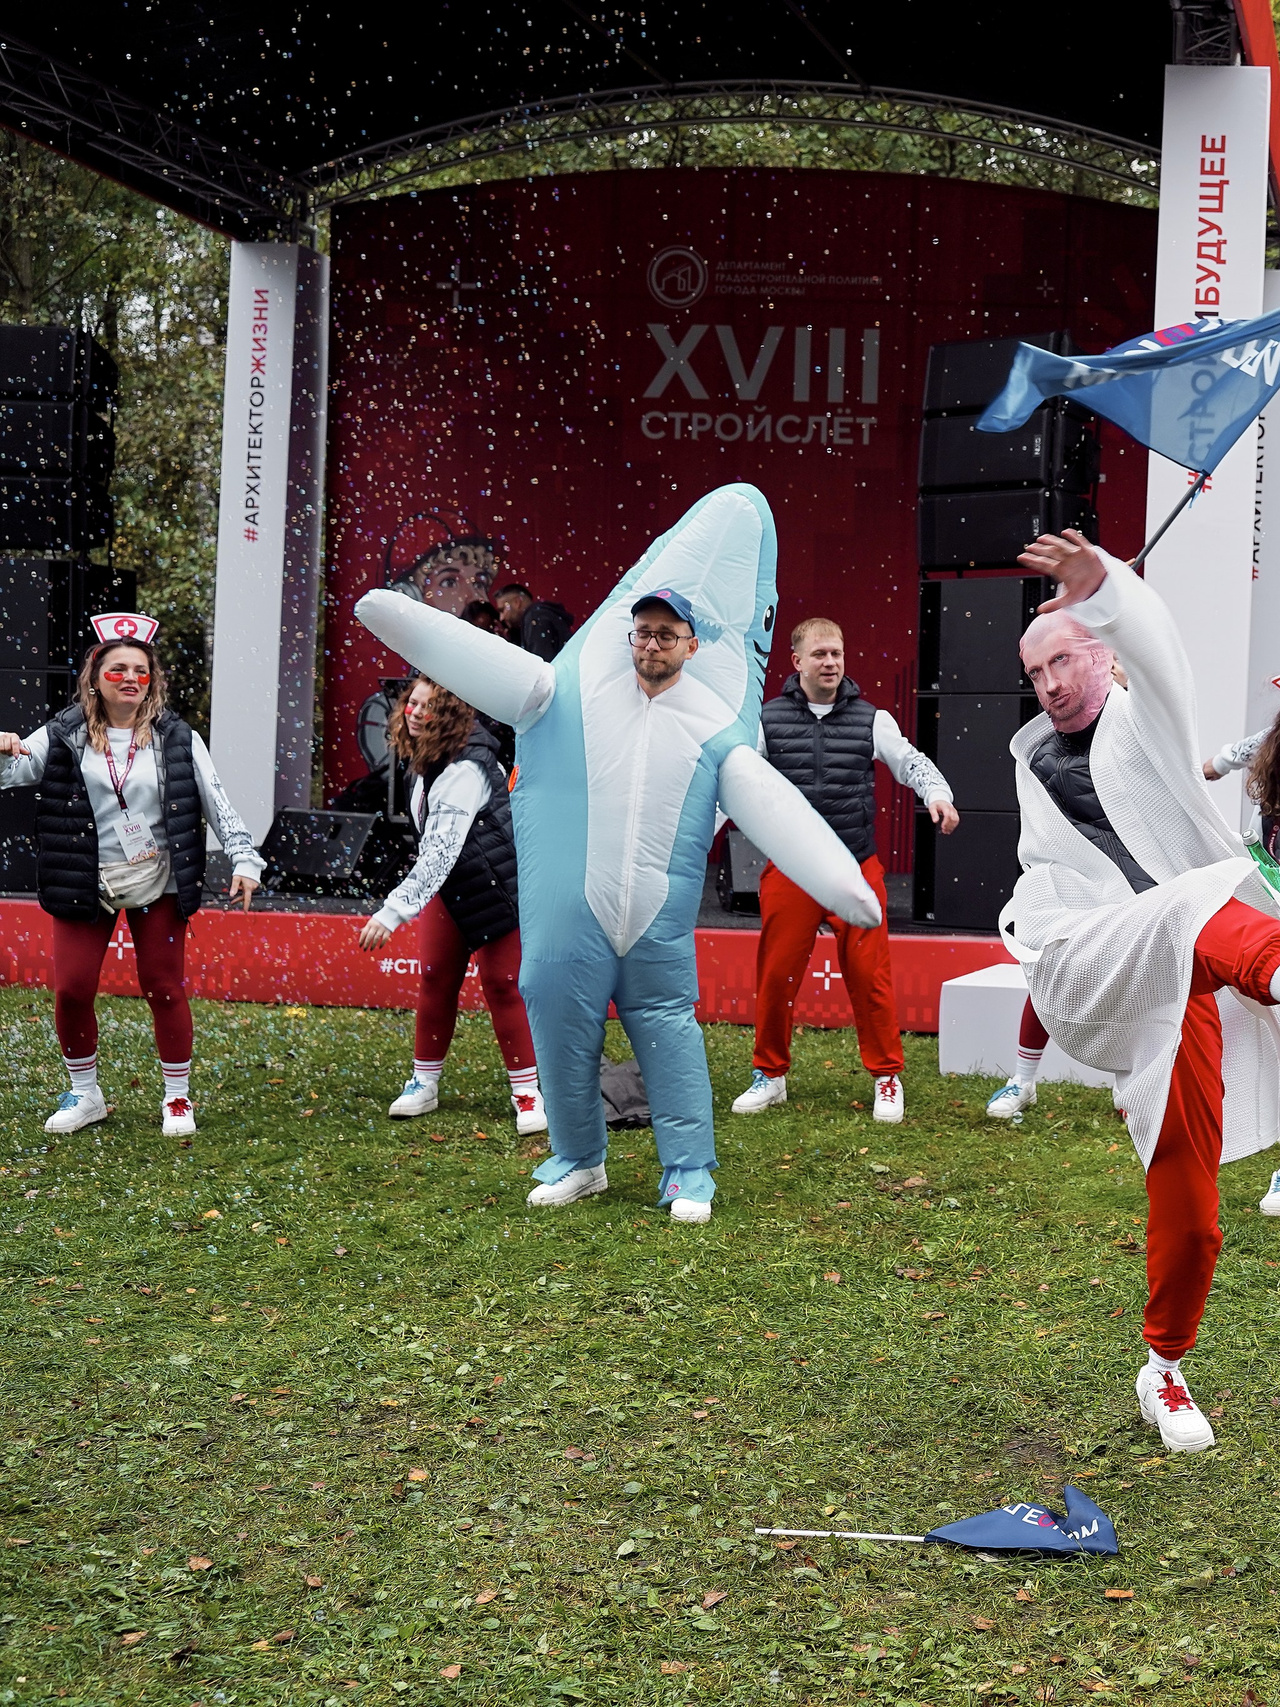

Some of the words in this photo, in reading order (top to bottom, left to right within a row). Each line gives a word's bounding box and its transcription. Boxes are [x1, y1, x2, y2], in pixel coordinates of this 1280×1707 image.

[715, 272, 825, 285] ГРАДОСТРОИТЕЛЬНОЙ
[828, 275, 882, 286] ПОЛИТИКИ
[716, 261, 786, 271] ДЕПАРТАМЕНТ
[715, 284, 757, 295] ГОРОДА
[760, 285, 806, 297] МОСКВЫ
[642, 323, 881, 404] XVIII
[244, 288, 270, 543] #АРХИТЕКТОРЖИЗНИ
[641, 404, 878, 446] СТРОЙСЛЁТ
